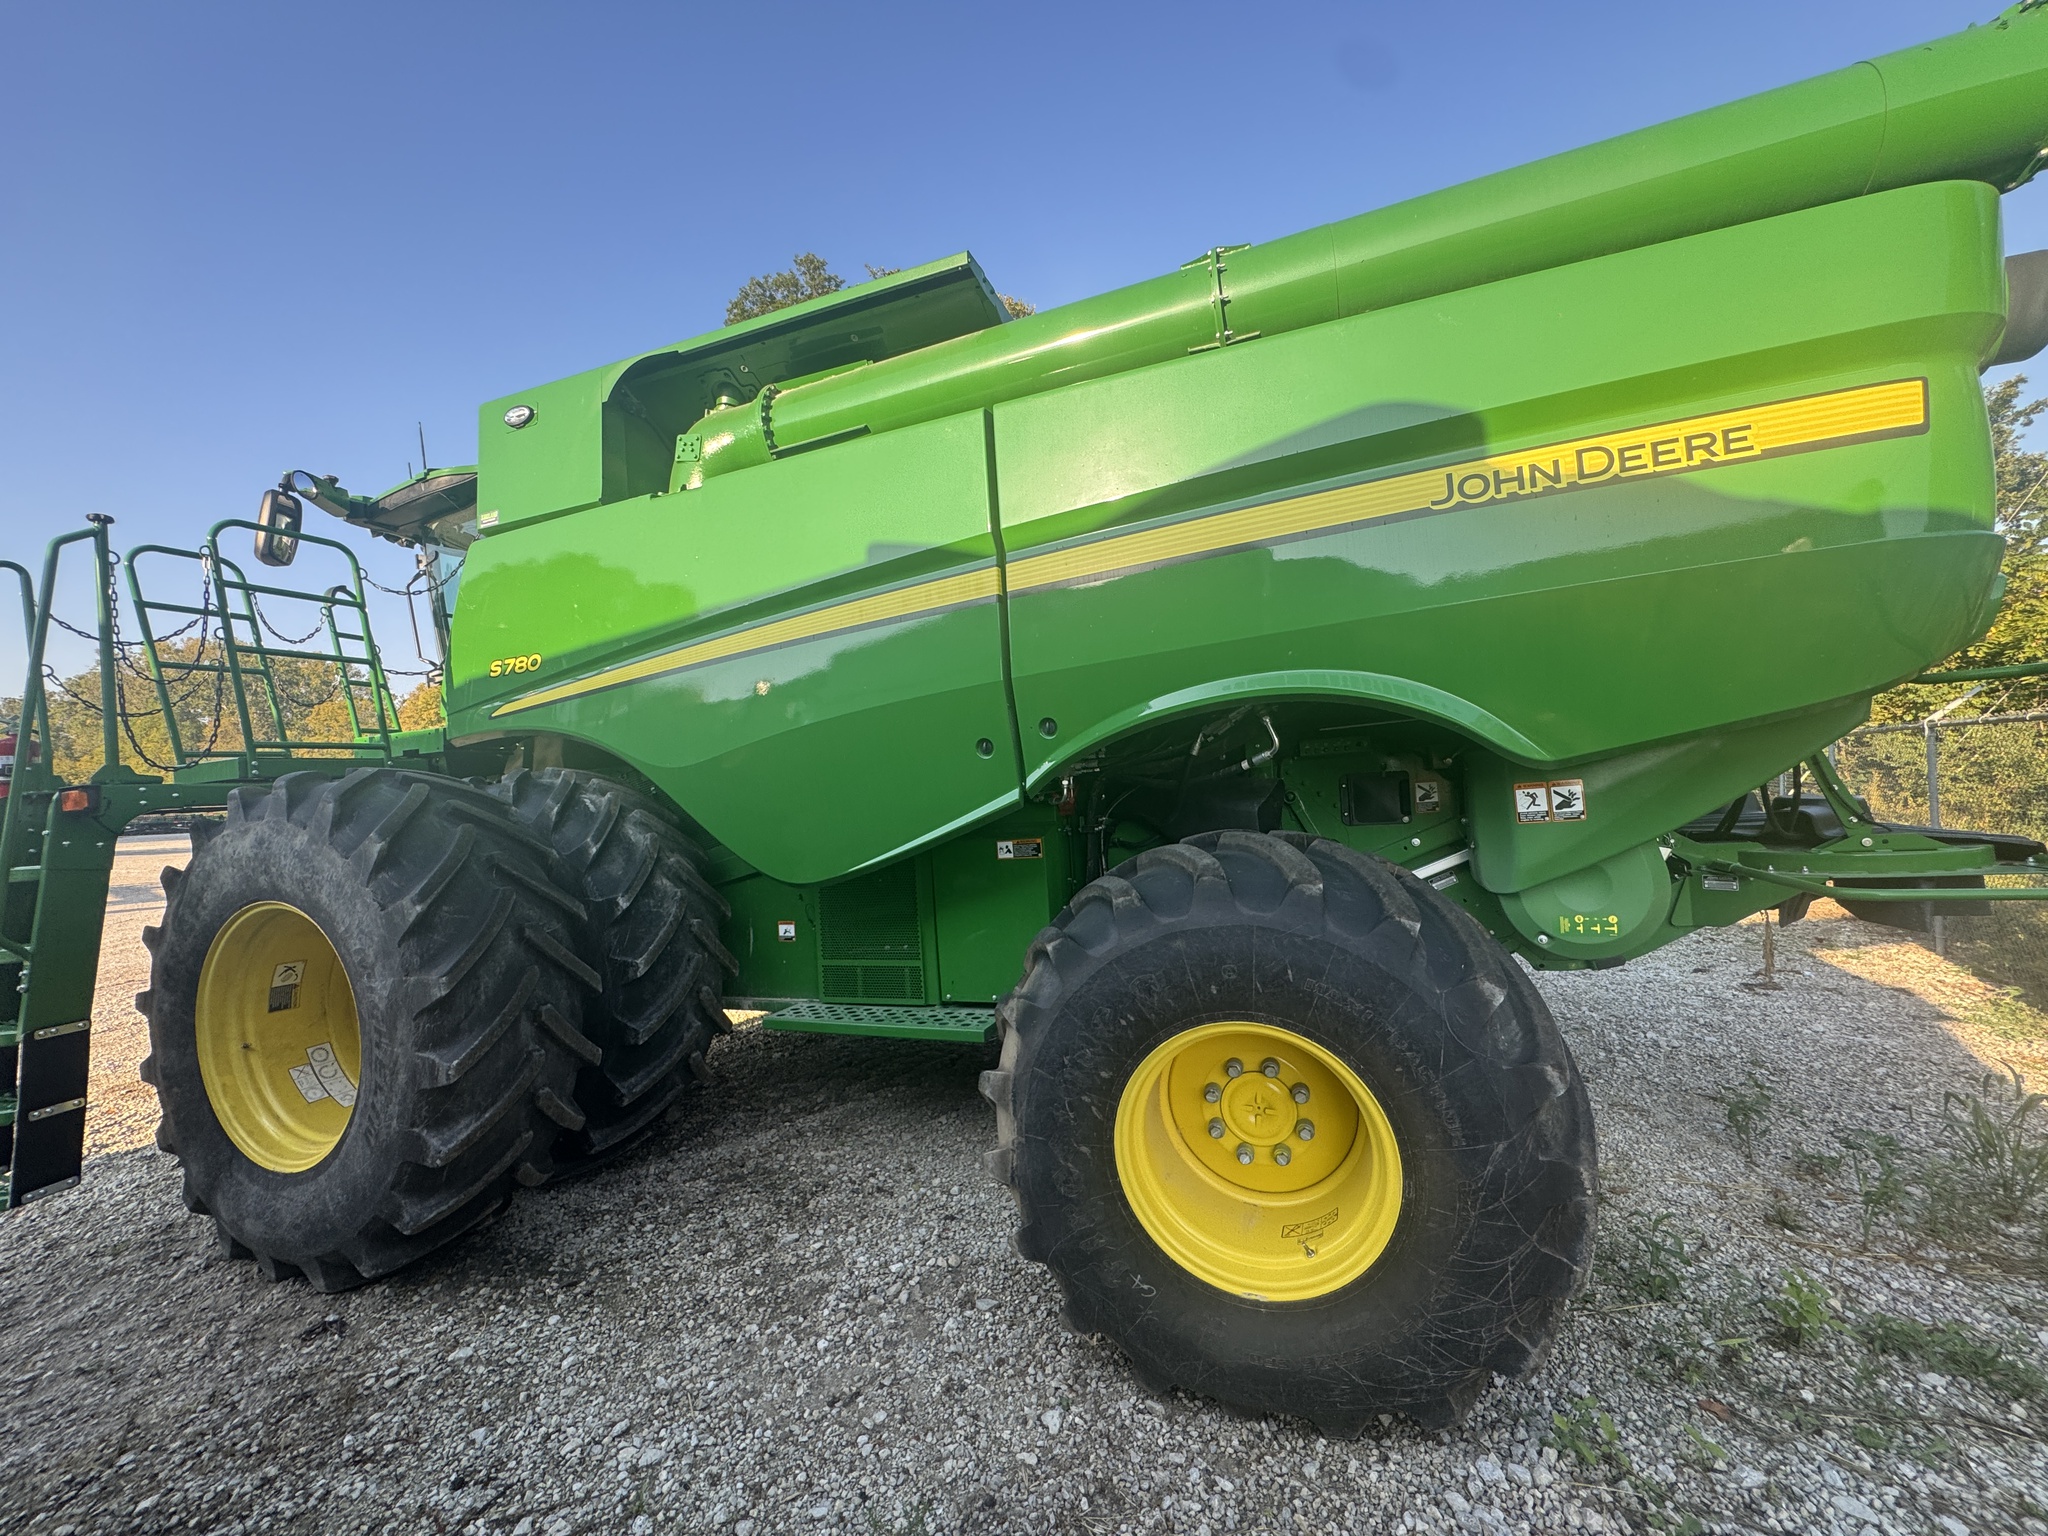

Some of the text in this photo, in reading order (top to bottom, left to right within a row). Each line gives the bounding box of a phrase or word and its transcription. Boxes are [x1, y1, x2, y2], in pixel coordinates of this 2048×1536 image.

[1430, 424, 1755, 506] JOHN DEERE
[489, 653, 542, 677] S780
